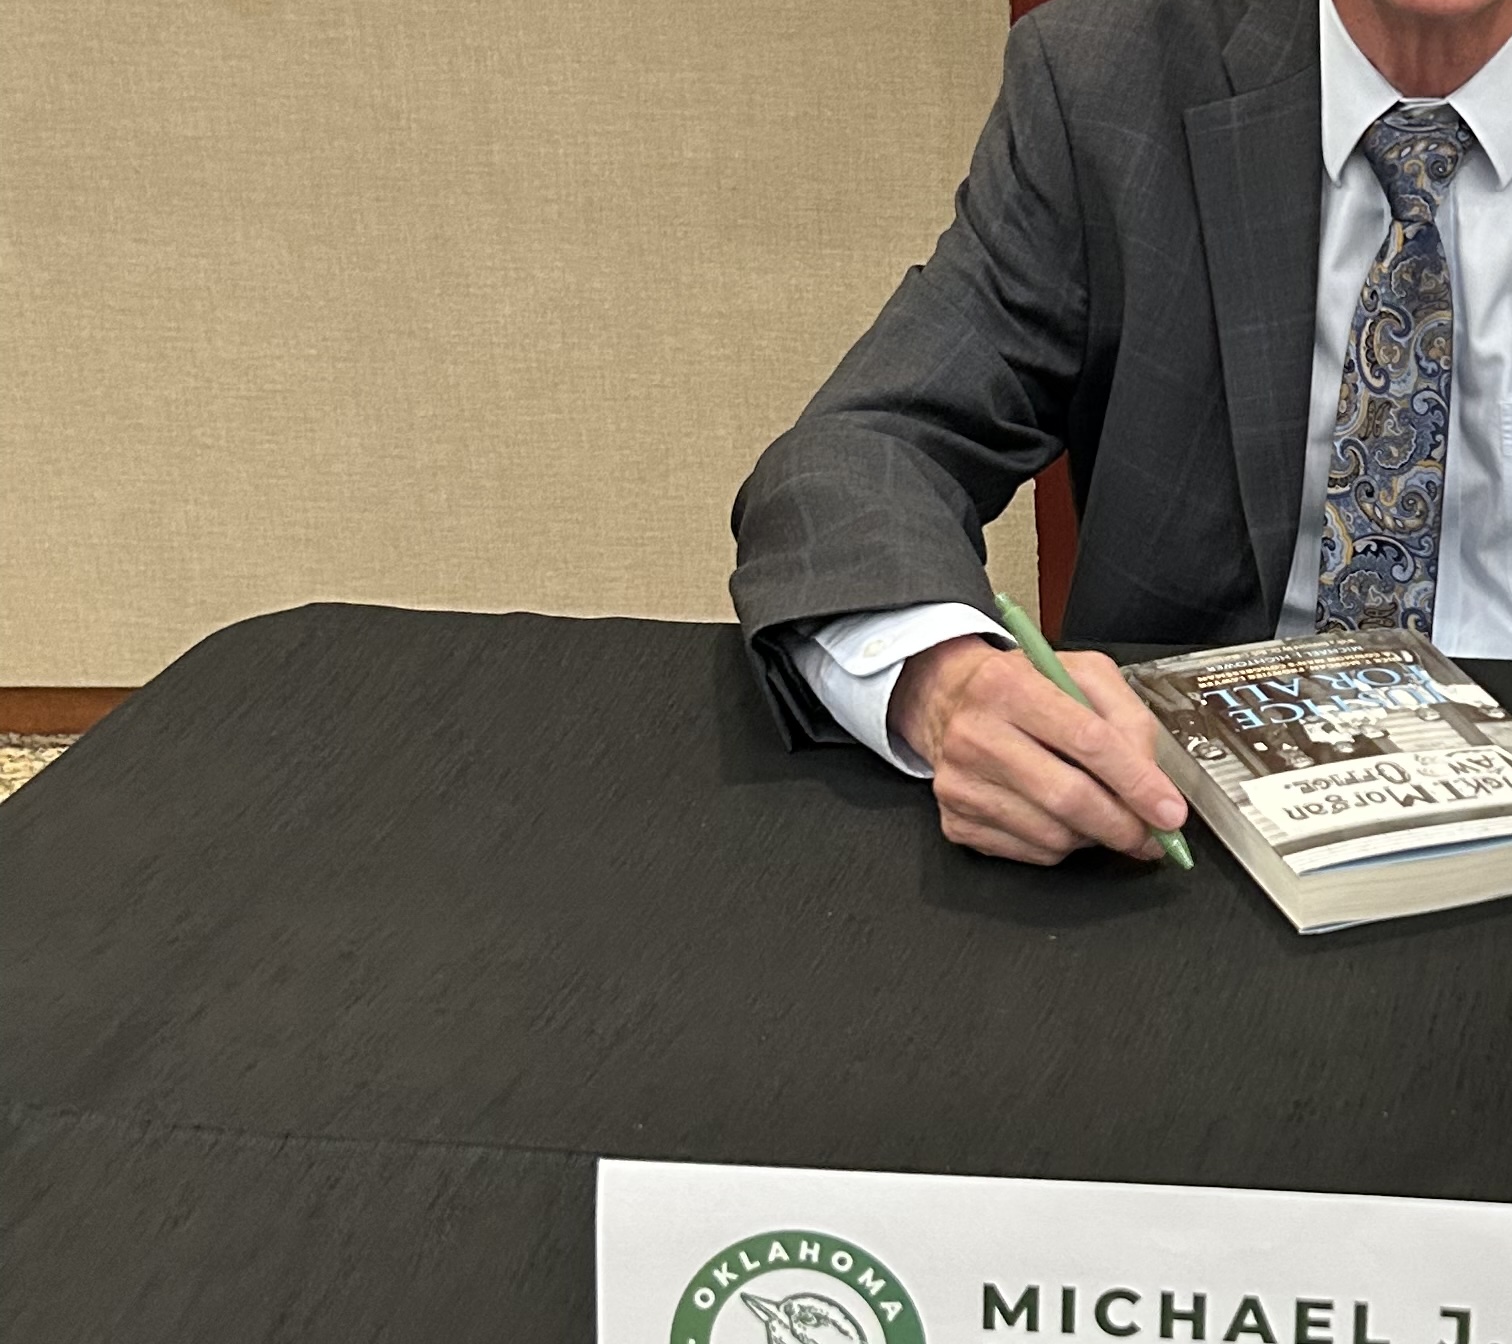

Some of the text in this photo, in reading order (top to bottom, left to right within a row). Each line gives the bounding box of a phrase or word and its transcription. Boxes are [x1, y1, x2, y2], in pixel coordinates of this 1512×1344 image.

[1202, 665, 1429, 709] FOR ALL
[1228, 682, 1449, 731] JUSTICE
[693, 1240, 904, 1323] OKLAHOMA
